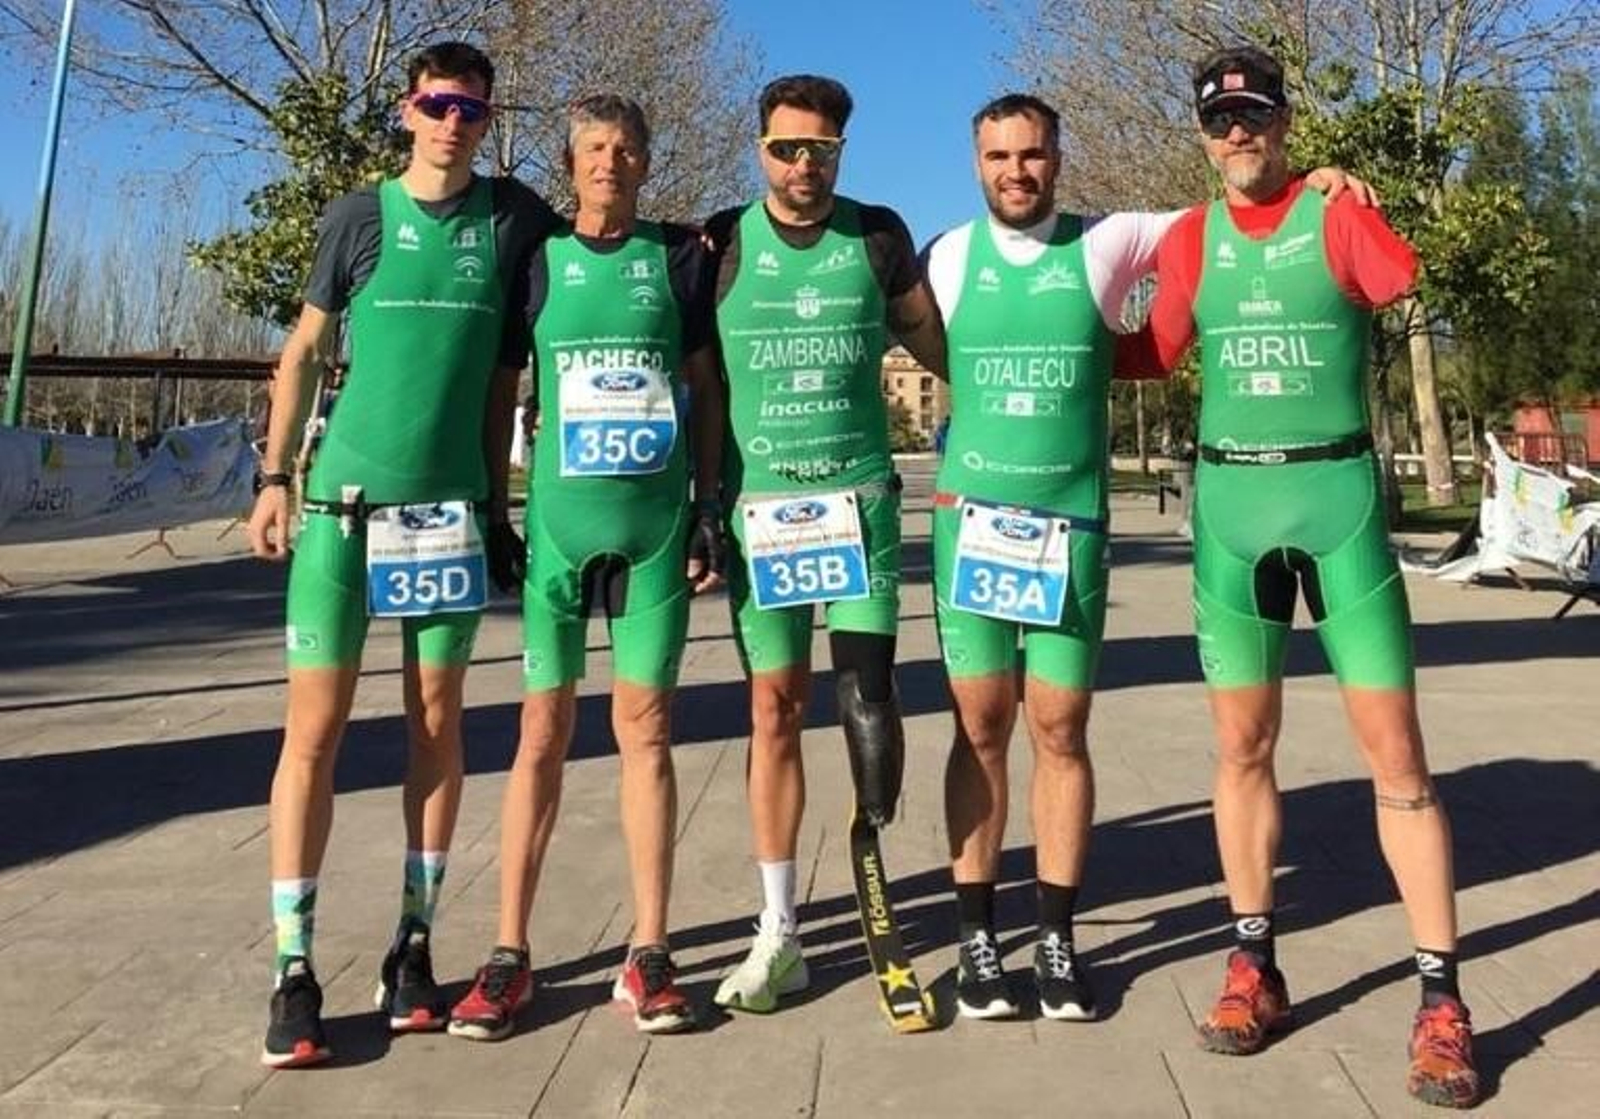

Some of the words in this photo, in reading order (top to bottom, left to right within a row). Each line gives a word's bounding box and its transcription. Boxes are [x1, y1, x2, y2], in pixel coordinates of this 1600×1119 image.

[555, 349, 664, 374] PACHECO
[749, 335, 869, 370] ZAMBRANA
[1218, 335, 1325, 368] ABRIL
[974, 357, 1076, 388] OTALECU
[577, 427, 659, 463] 35C
[386, 565, 471, 606] 35D
[770, 554, 850, 597] 35B
[968, 567, 1047, 615] 35A
